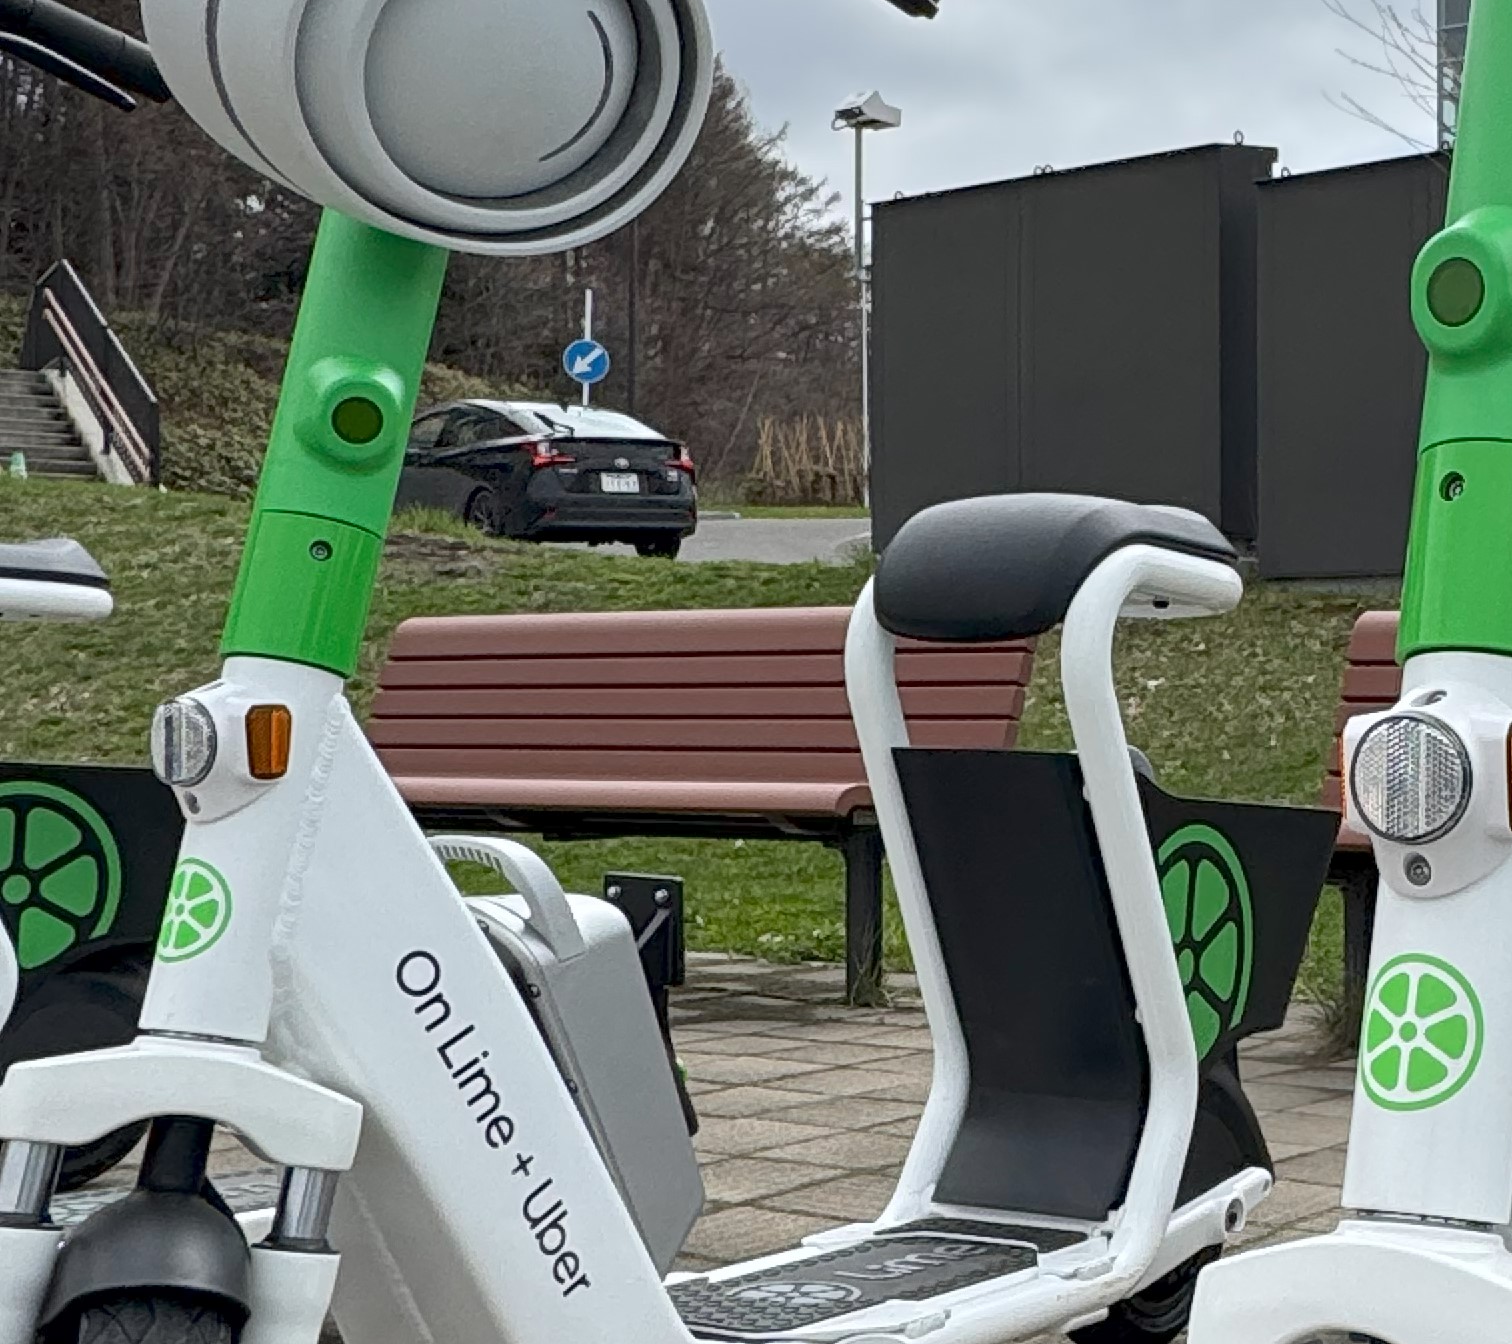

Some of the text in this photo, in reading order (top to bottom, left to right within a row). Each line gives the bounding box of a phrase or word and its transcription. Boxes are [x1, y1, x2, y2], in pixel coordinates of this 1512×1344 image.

[396, 949, 591, 1297] On Lime + Uber
[833, 1244, 988, 1280] Lime
